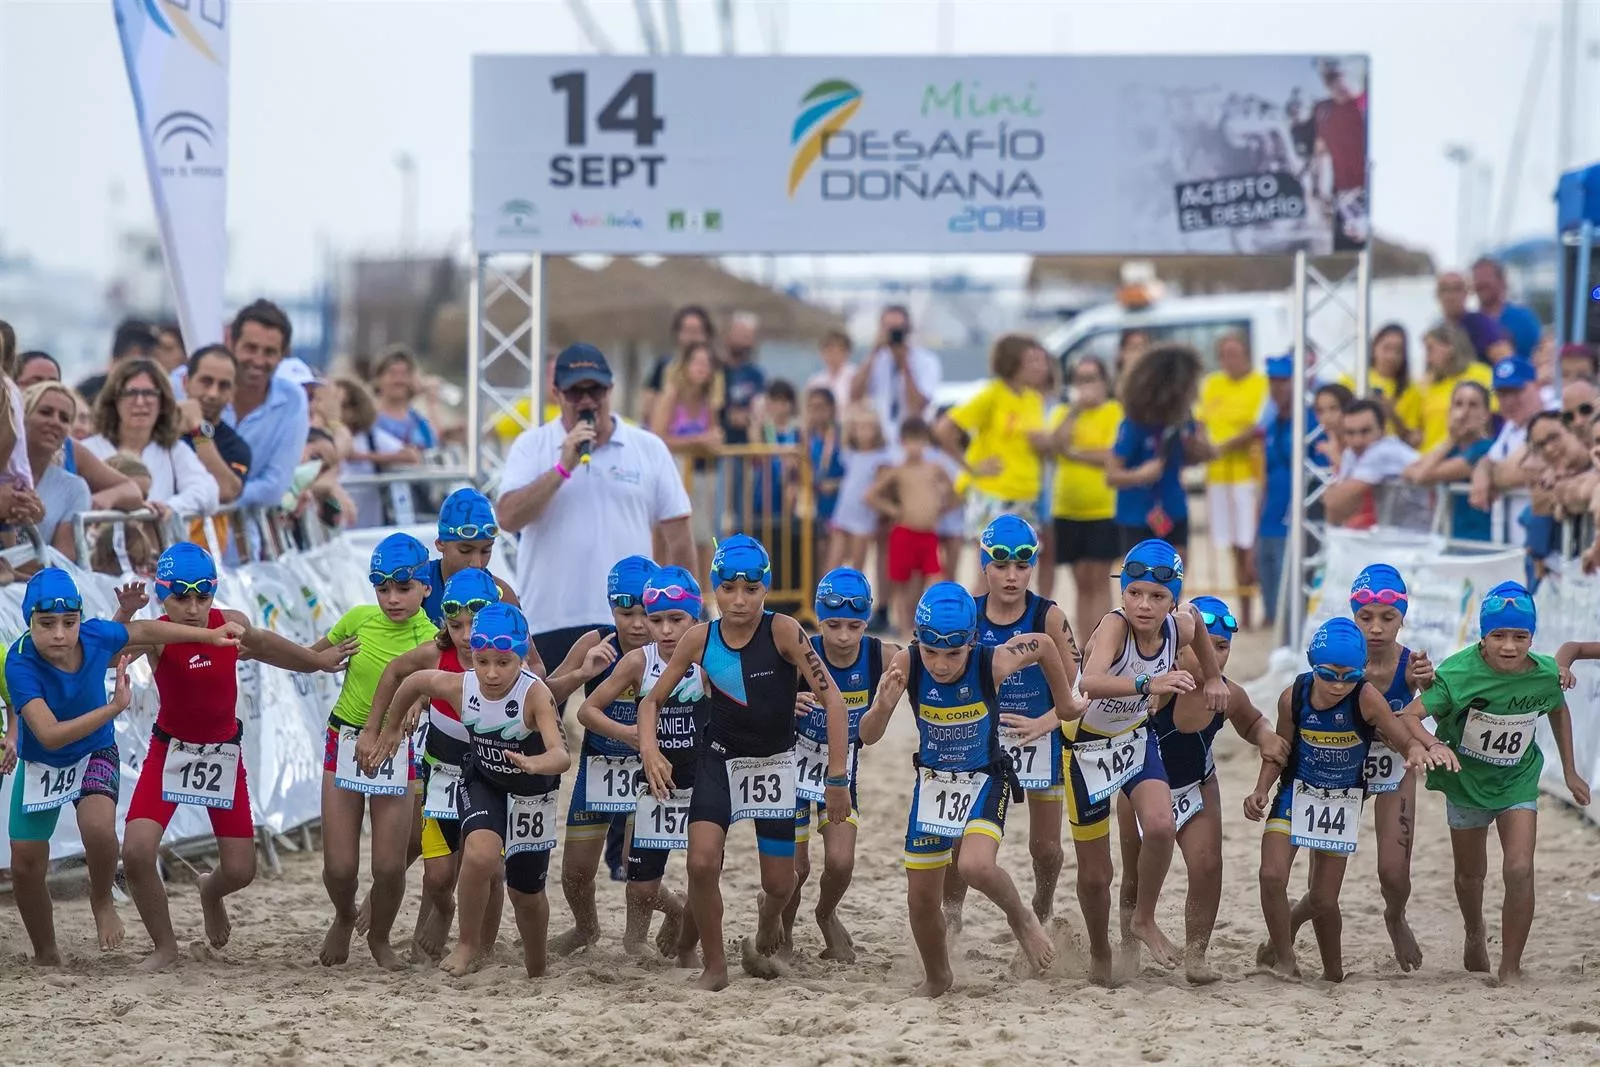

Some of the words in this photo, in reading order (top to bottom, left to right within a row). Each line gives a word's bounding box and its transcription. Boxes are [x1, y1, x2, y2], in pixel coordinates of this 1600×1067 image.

[549, 70, 665, 148] 14
[919, 80, 1044, 119] Mini
[820, 122, 1046, 162] DESAFÍO
[549, 153, 667, 189] SEPT
[820, 164, 1044, 201] DOÑANA
[1180, 174, 1279, 208] ACEPTO
[947, 204, 1047, 233] 2018
[1181, 208, 1209, 231] EL
[189, 660, 212, 670] skinfit
[946, 708, 981, 721] CORIA
[927, 723, 979, 741] RODRIGUEZ
[1324, 734, 1359, 745] CORIA
[1479, 729, 1523, 755] 148
[480, 759, 526, 775] mobe
[1096, 744, 1136, 783] 142
[1312, 748, 1351, 763] CASTRO
[40, 766, 76, 798] 149
[180, 761, 223, 793] 152
[797, 756, 828, 787] 14
[739, 773, 782, 804] 153
[650, 804, 690, 834] 157
[935, 790, 971, 823] 138
[1304, 804, 1346, 836] 144
